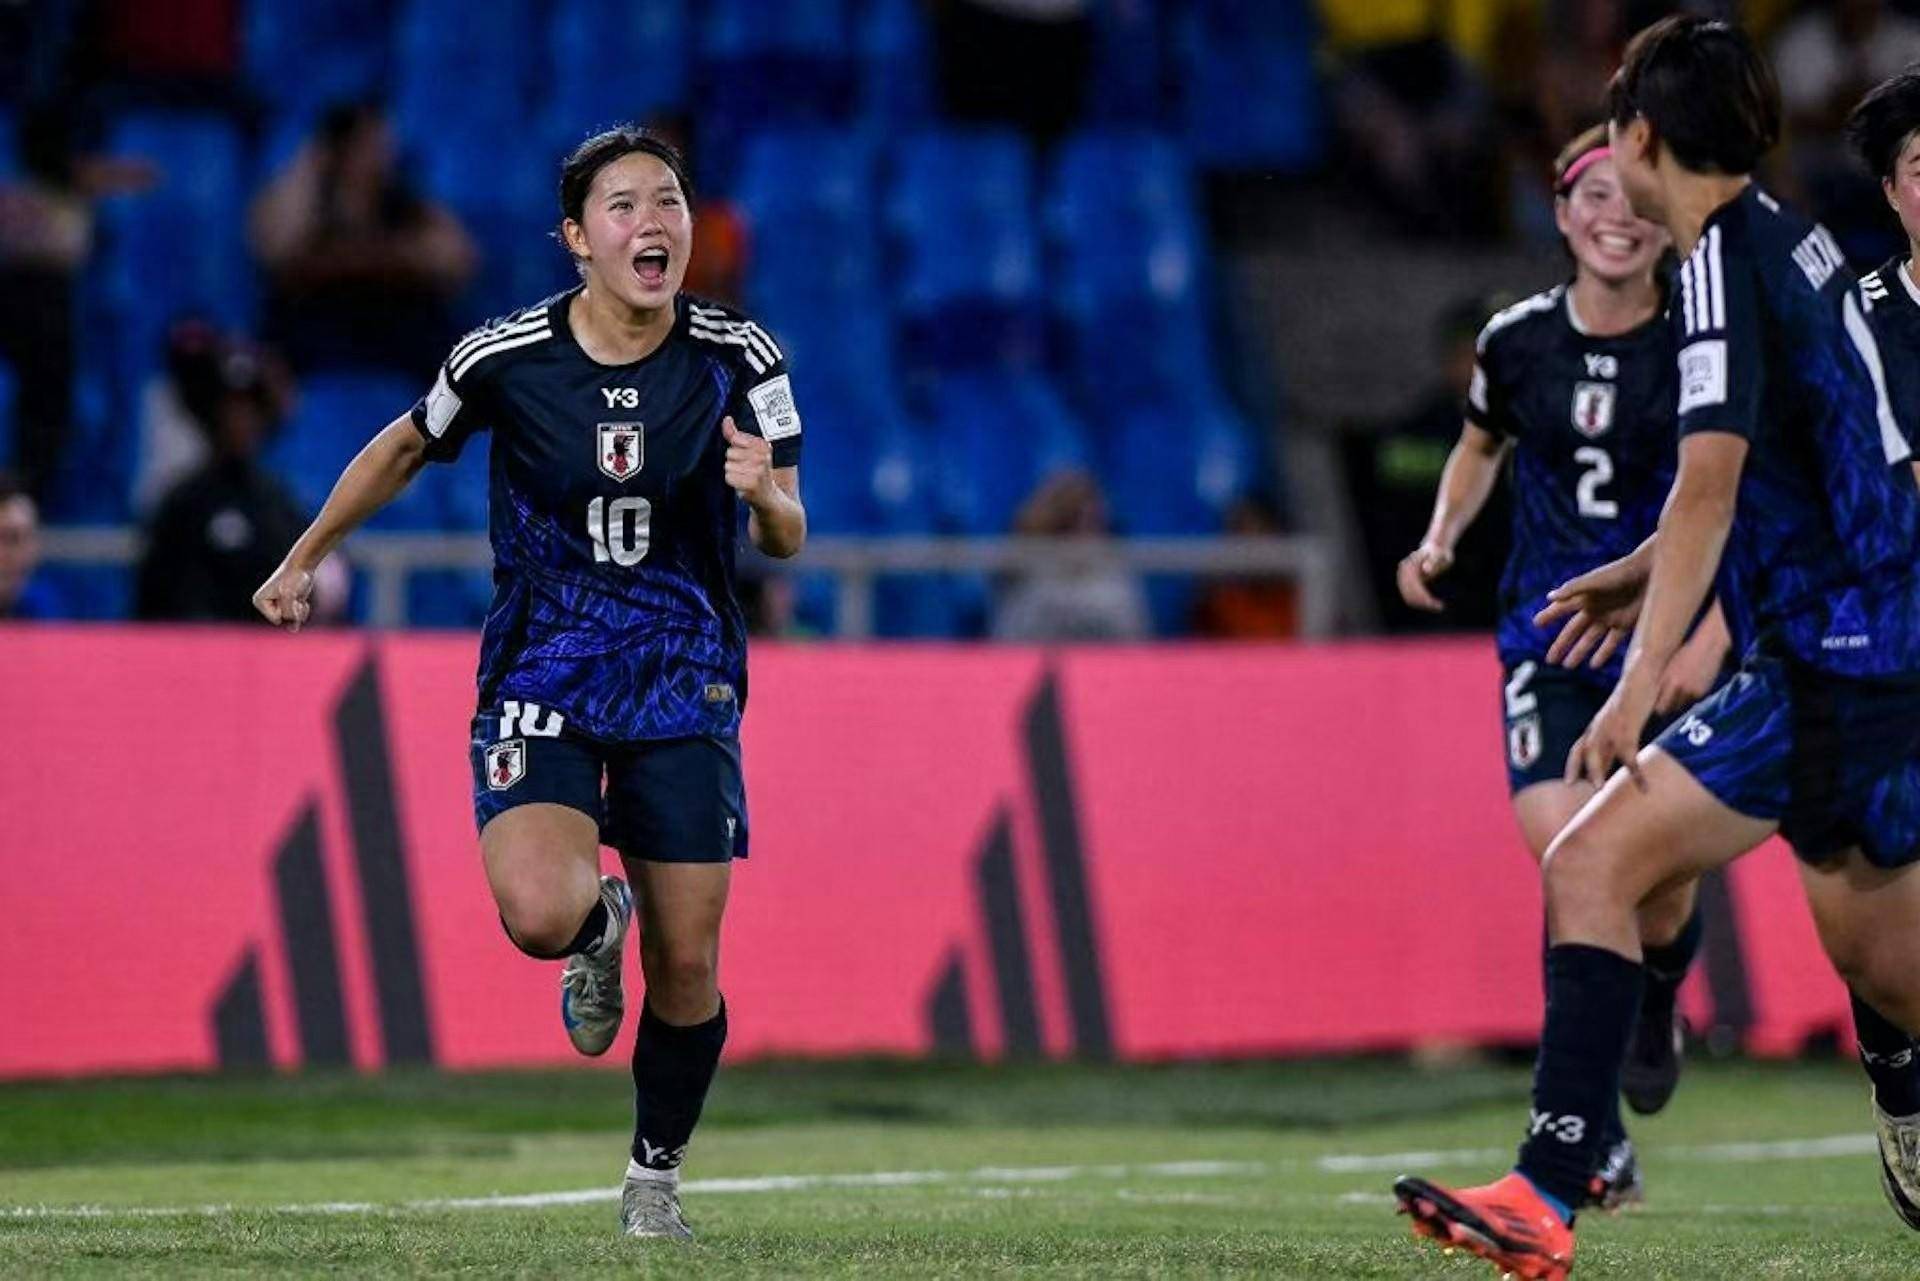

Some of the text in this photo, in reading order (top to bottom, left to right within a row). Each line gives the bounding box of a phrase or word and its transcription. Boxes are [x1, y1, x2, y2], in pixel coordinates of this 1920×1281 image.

[601, 387, 639, 409] Y-3
[1574, 446, 1619, 519] 2
[588, 496, 651, 566] 10
[1505, 660, 1538, 719] 2
[1530, 1108, 1586, 1144] Y-3
[642, 1137, 688, 1167] Y-3
